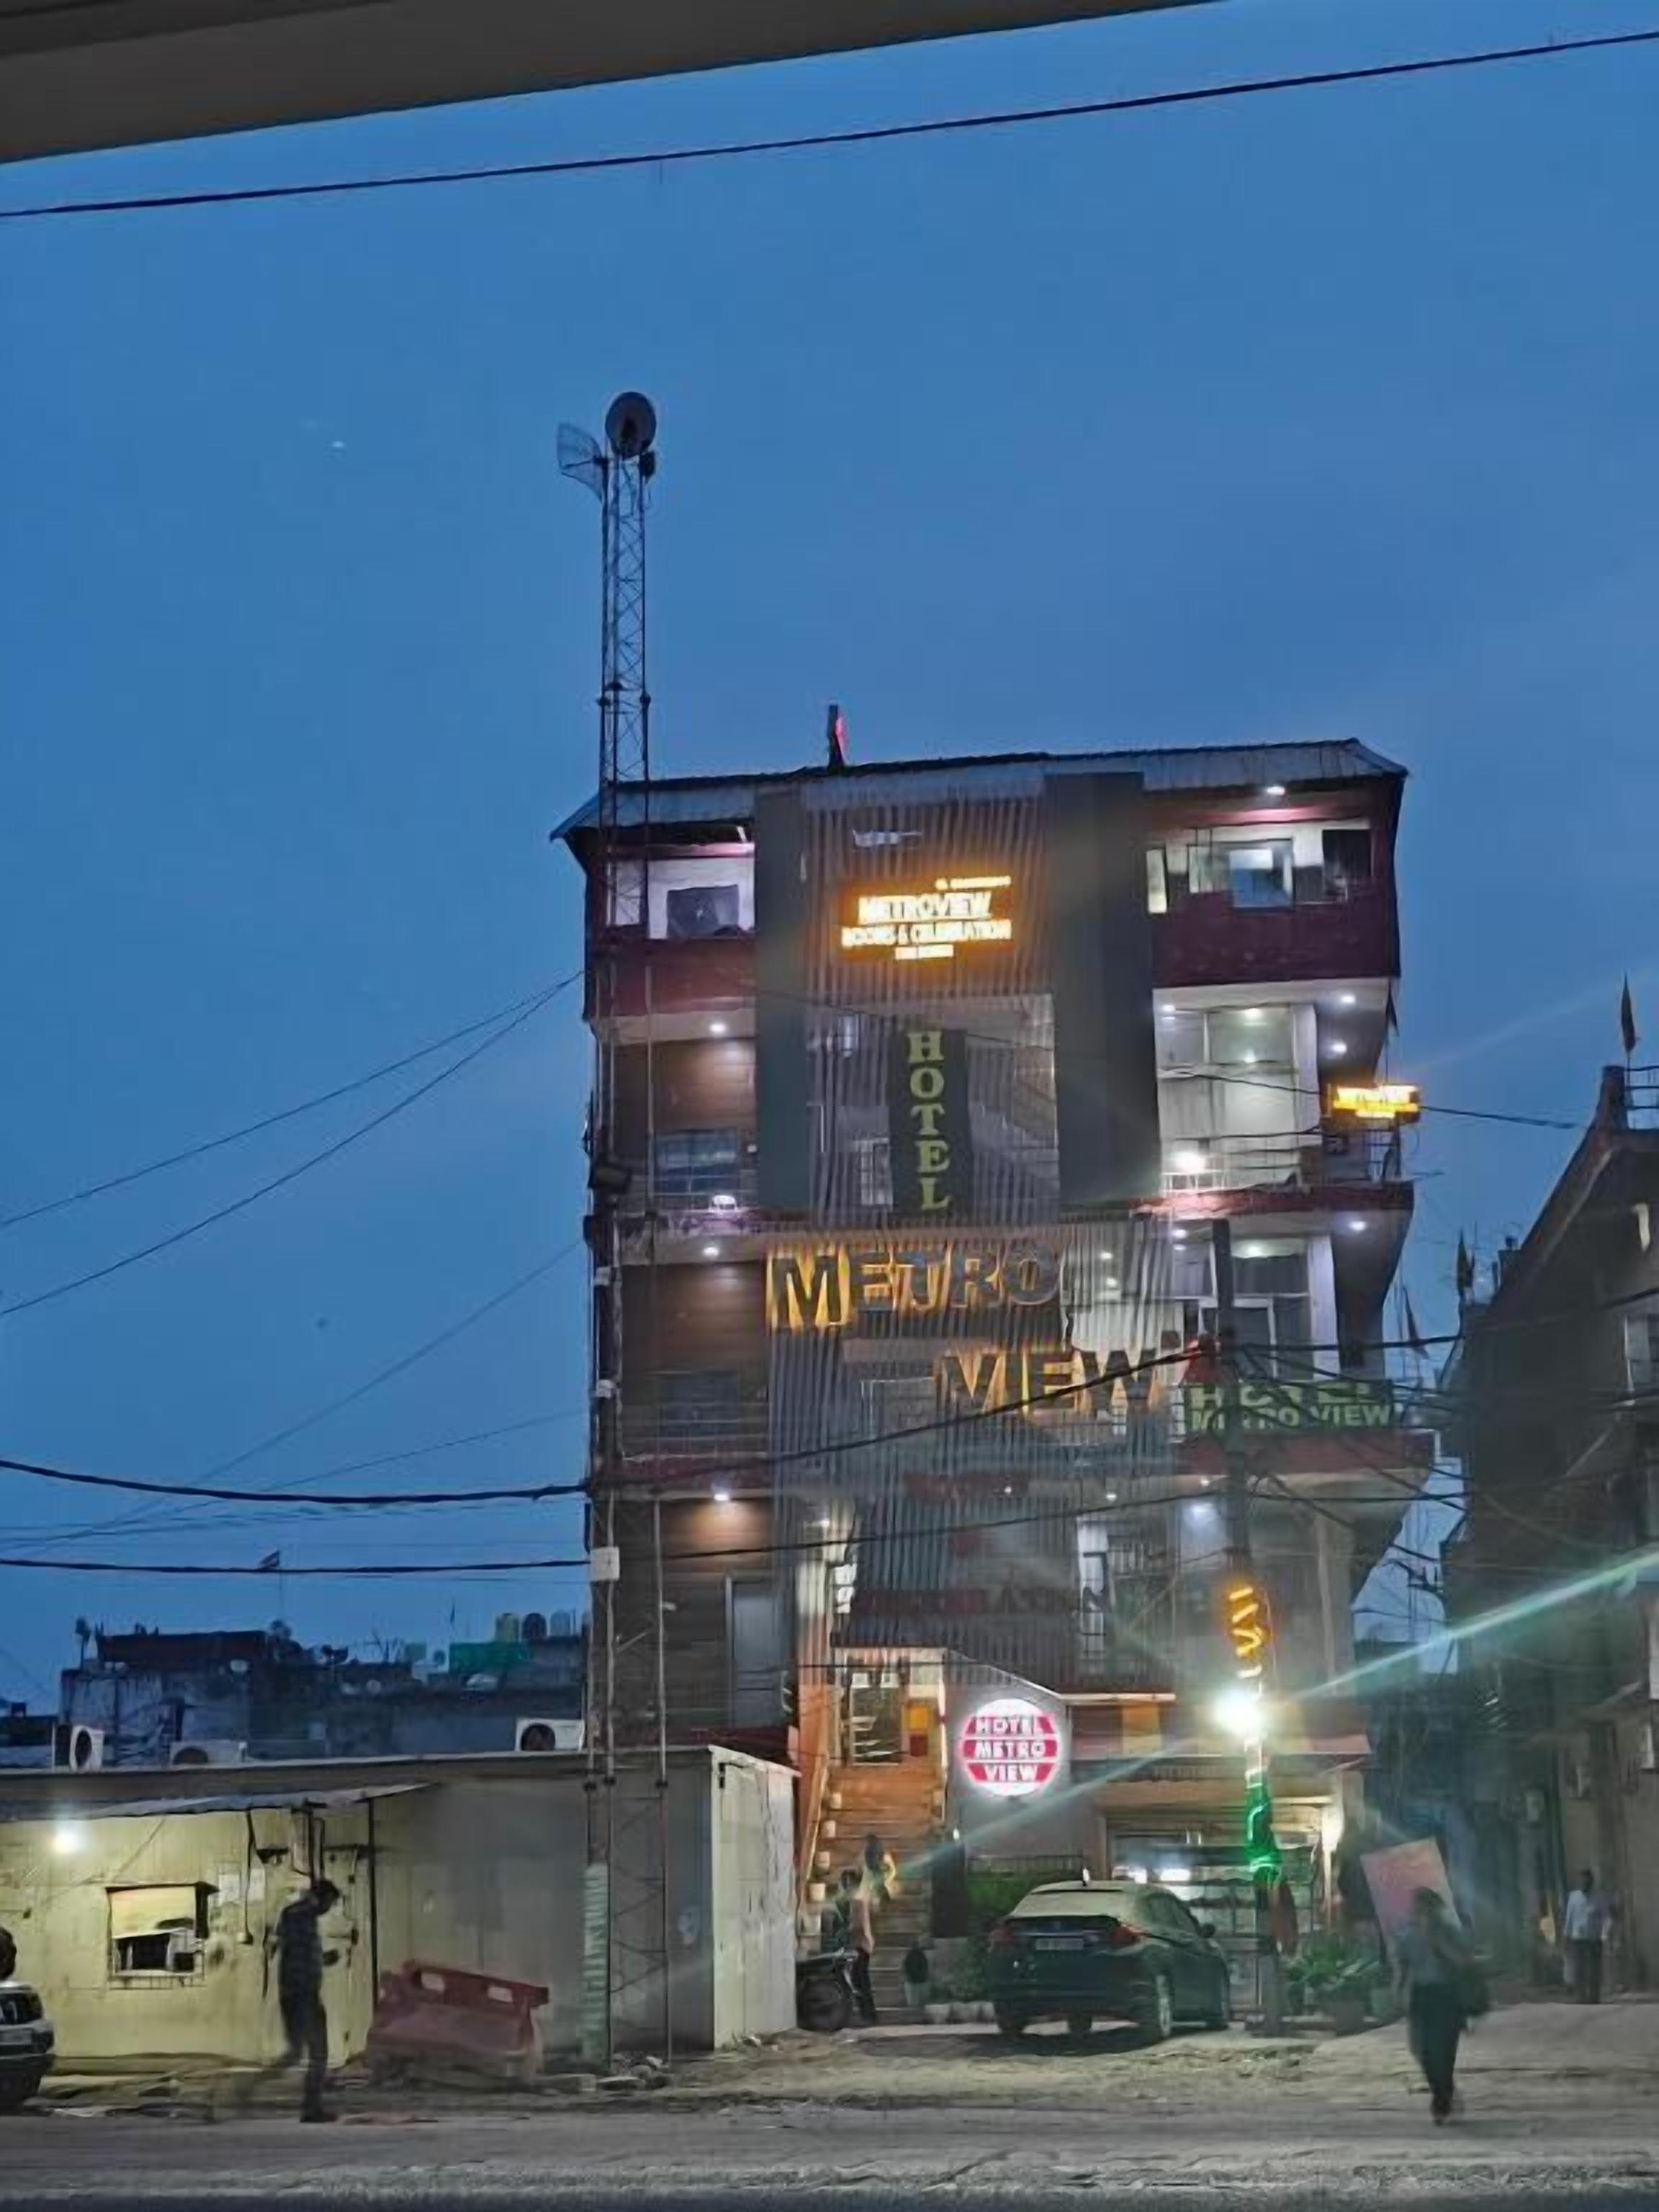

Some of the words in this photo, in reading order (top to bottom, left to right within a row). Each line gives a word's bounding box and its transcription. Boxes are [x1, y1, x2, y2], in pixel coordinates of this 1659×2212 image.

[907, 1030, 950, 1211] HOTEL
[1310, 1404, 1391, 1426] VIEW
[976, 1717, 1041, 1734] HOTEL
[976, 1741, 1046, 1758] METRO
[984, 1764, 1039, 1782] VIEW
